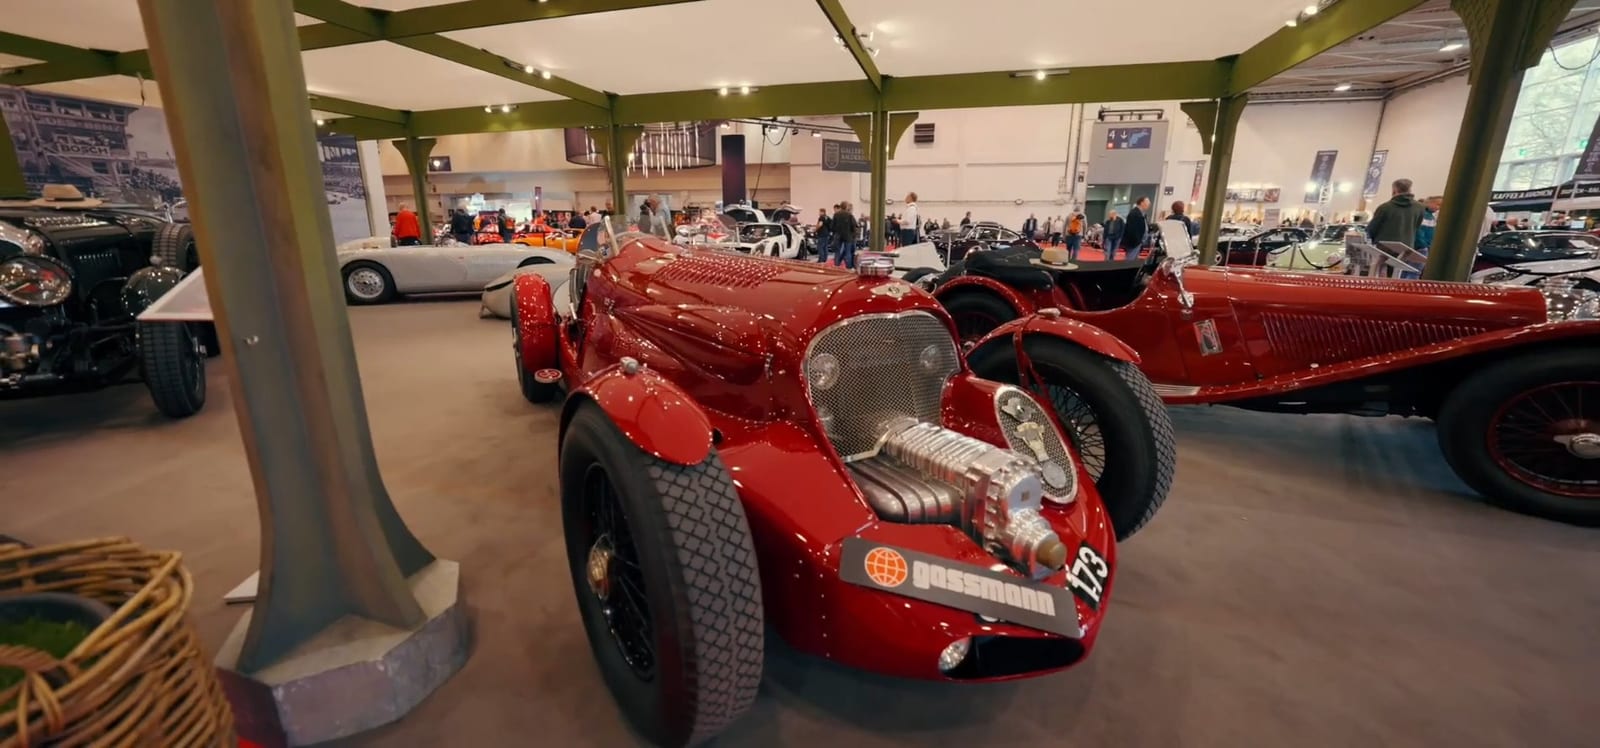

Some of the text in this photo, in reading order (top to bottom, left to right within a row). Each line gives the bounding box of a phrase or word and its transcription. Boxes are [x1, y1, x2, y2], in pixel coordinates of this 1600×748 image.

[60, 144, 108, 154] BOSCH
[1108, 129, 1116, 140] 4
[913, 560, 1055, 616] gassmann
[1068, 546, 1108, 602] 173
